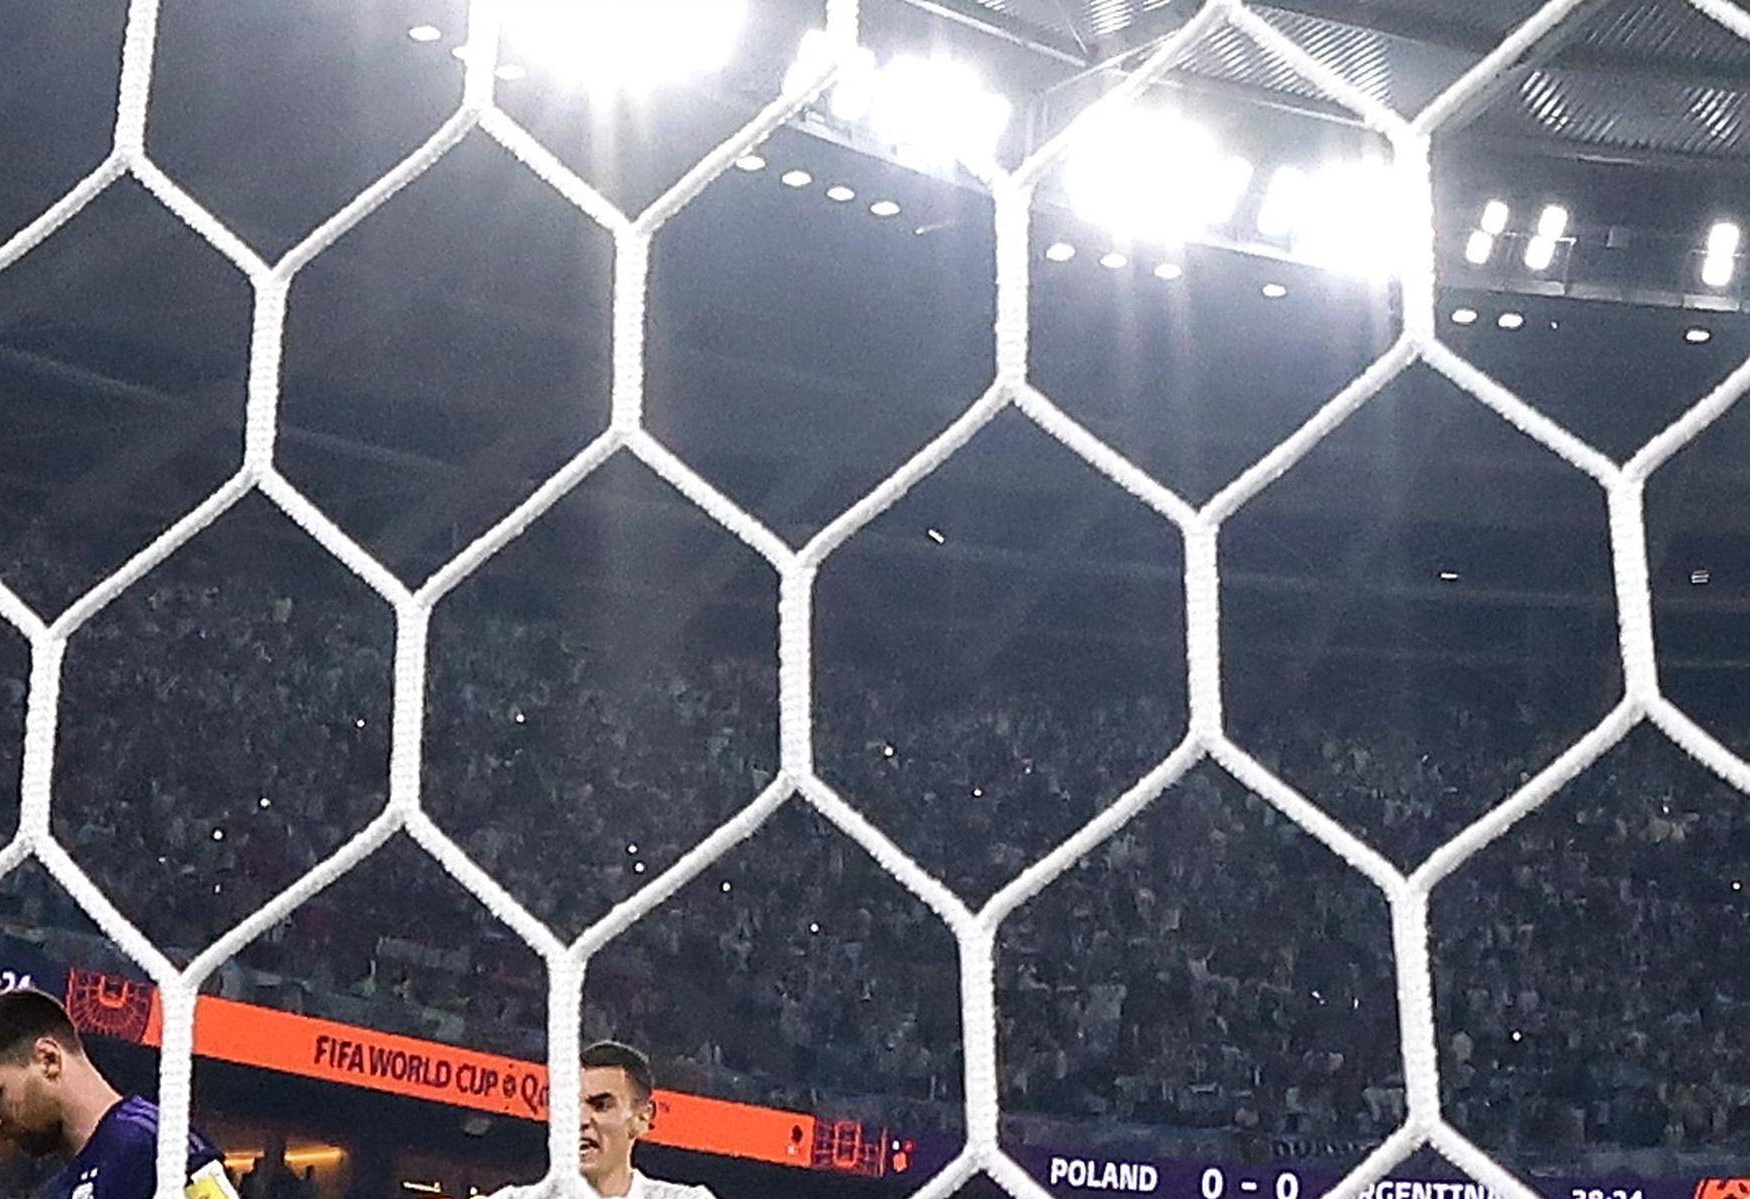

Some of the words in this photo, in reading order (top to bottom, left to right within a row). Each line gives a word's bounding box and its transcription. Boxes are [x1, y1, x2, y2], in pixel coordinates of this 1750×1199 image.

[314, 1035, 364, 1073] FIFA
[369, 1046, 451, 1088] WORLD
[456, 1064, 498, 1096] CUP
[1051, 1157, 1158, 1191] POLAND
[1201, 1168, 1223, 1199] 0
